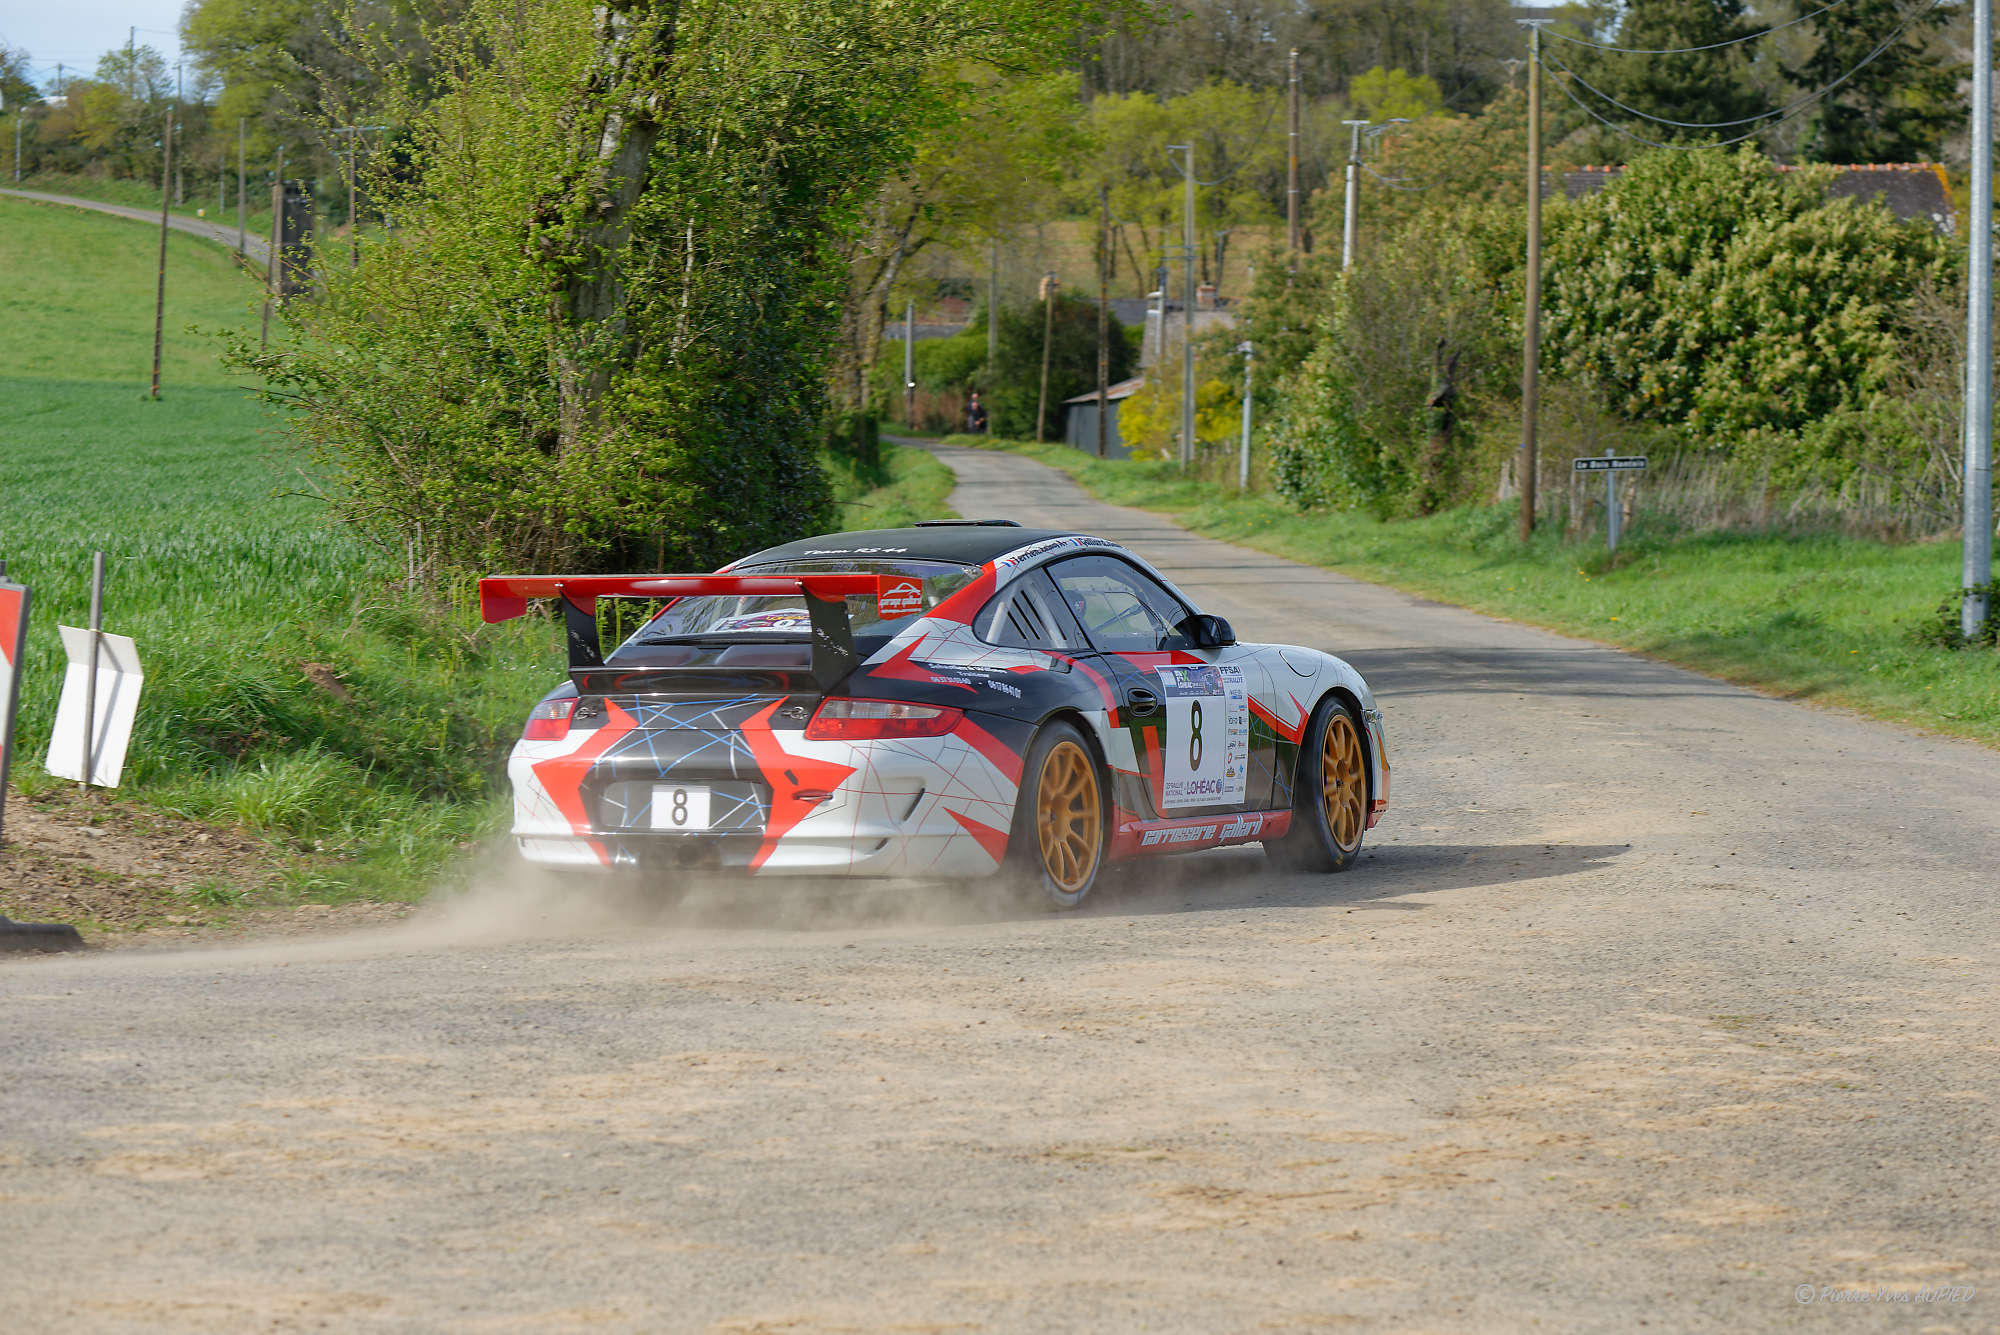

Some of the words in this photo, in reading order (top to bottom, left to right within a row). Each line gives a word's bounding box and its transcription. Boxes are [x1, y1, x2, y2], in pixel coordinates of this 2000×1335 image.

[1189, 699, 1203, 772] 8
[1186, 778, 1216, 795] LOHÉAC
[671, 788, 688, 826] 8
